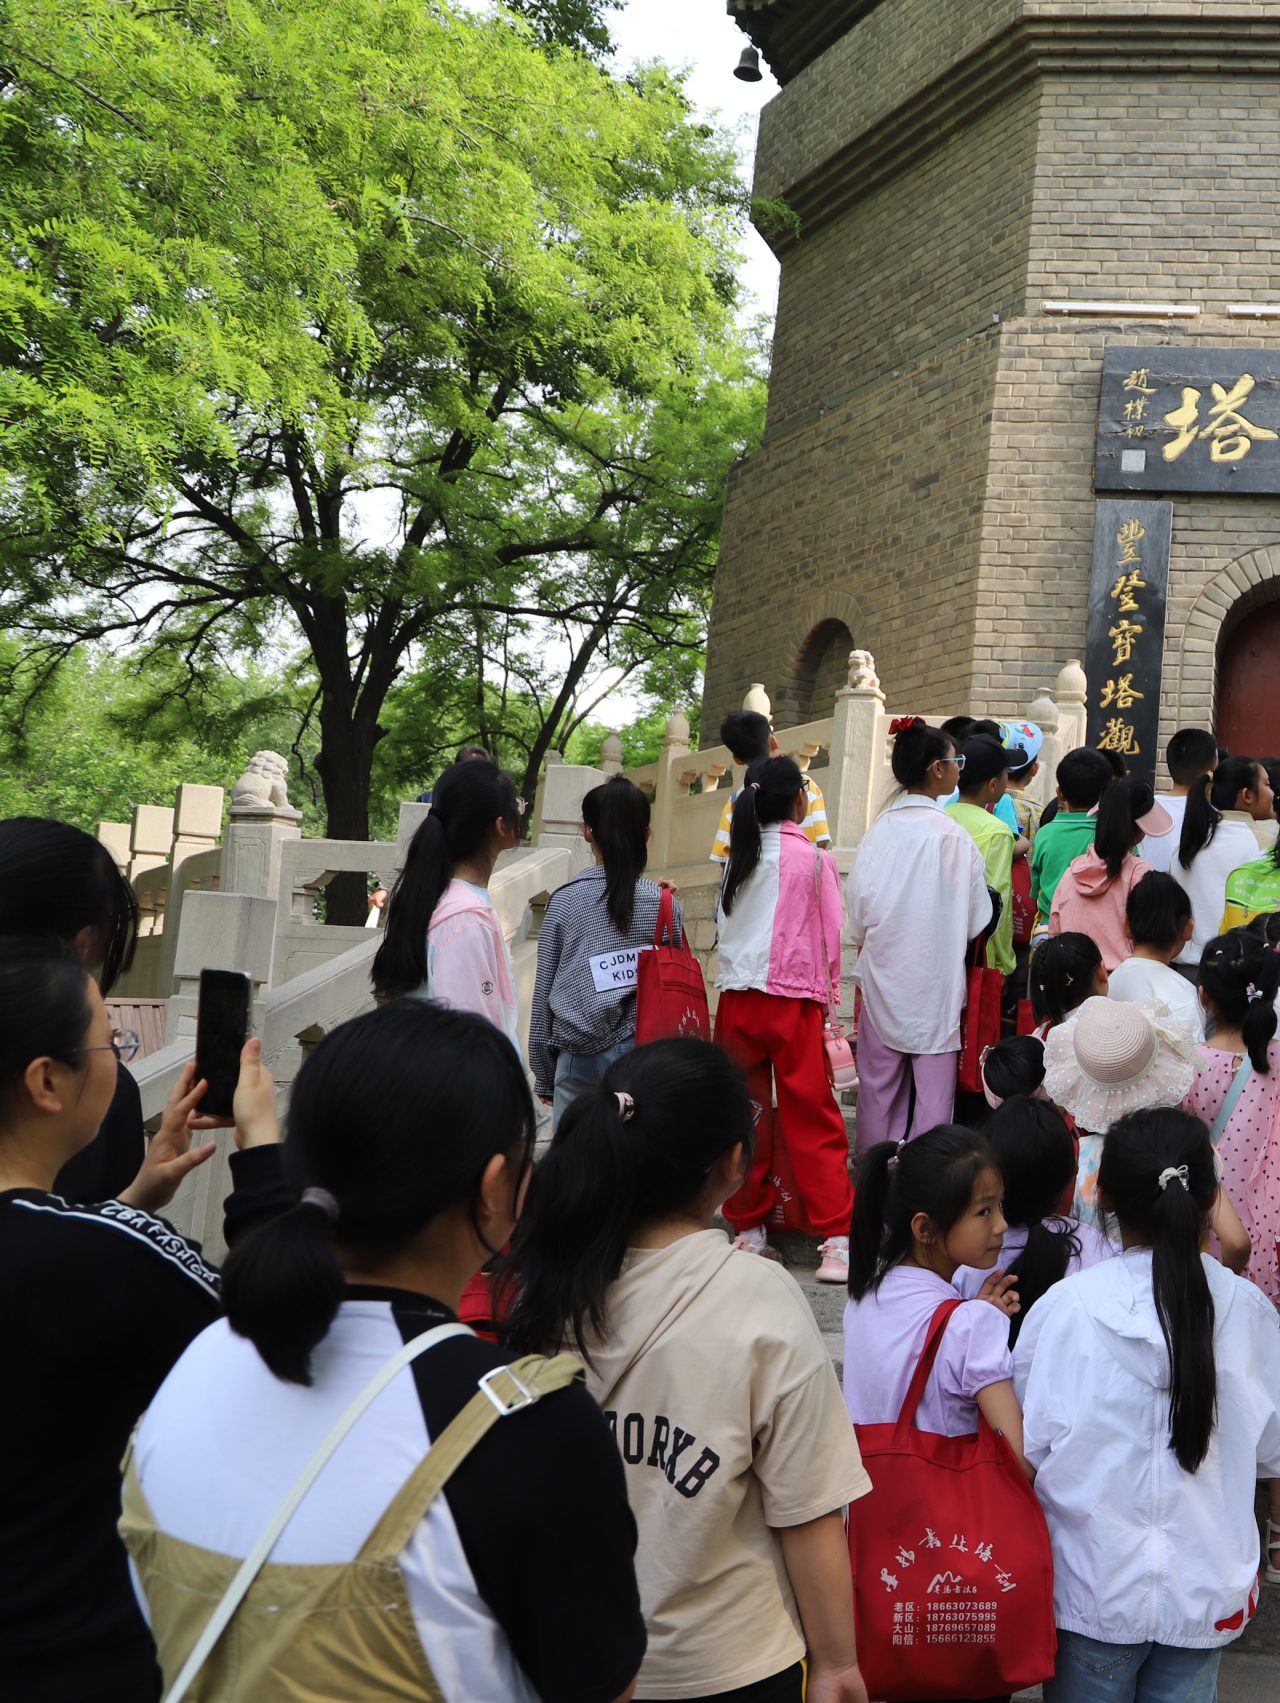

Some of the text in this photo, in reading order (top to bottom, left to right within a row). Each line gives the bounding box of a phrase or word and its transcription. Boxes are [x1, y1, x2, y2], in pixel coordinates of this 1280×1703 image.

[926, 1601, 998, 1611] 18663073689
[926, 1612, 997, 1622] 18763075995
[926, 1623, 996, 1632] 18769657089
